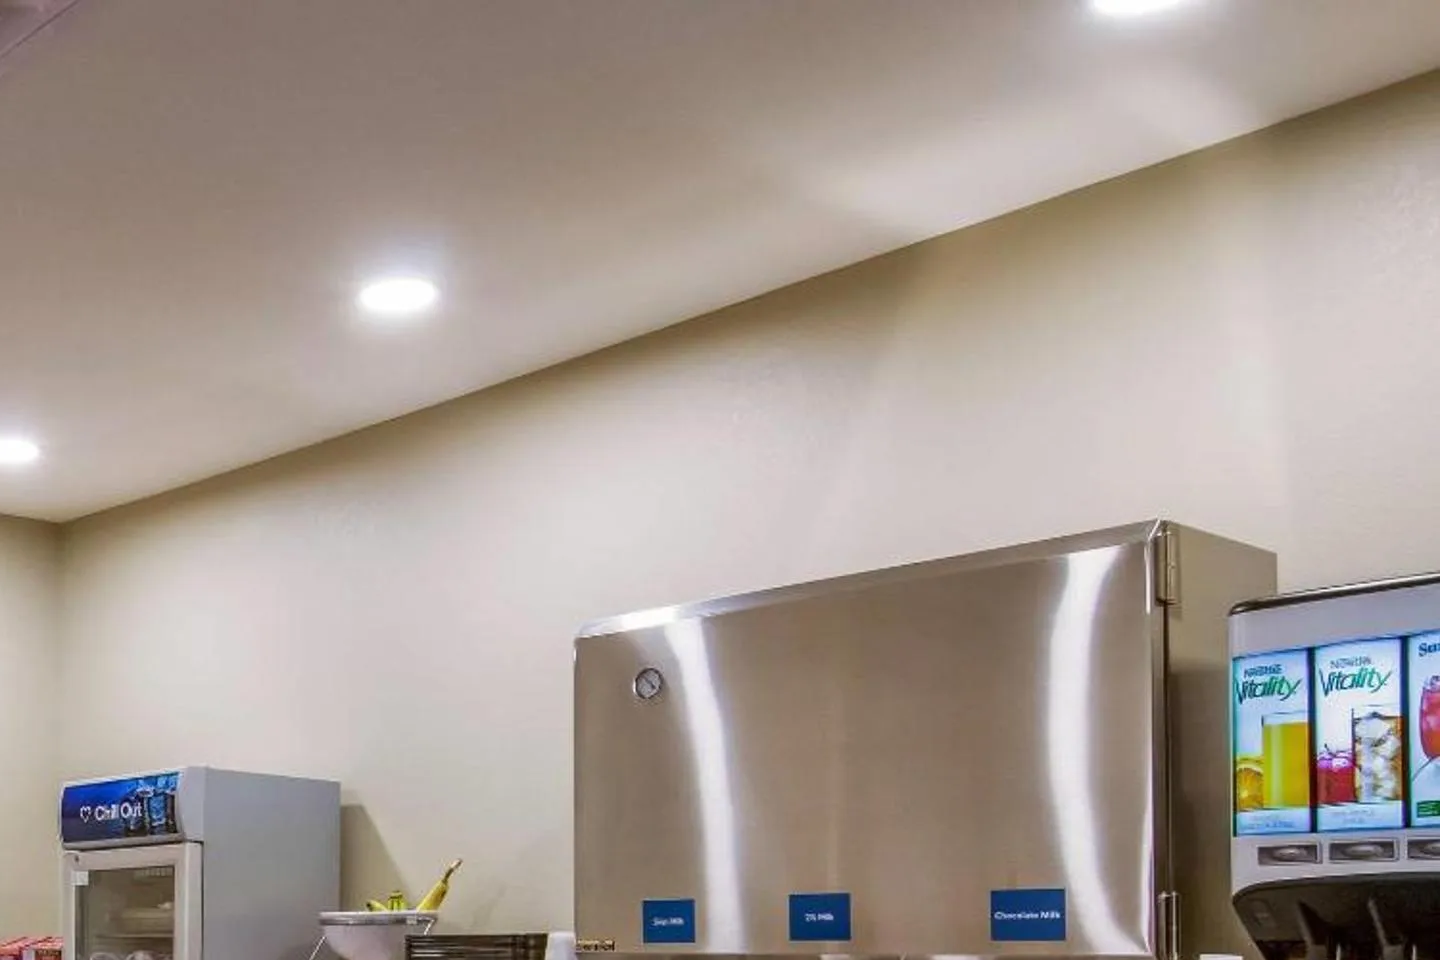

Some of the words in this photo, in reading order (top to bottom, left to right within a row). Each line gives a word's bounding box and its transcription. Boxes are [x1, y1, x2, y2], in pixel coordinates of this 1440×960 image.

[1234, 675, 1302, 704] Vitality
[1319, 666, 1392, 697] Vitality
[95, 804, 119, 821] Chill
[120, 802, 142, 819] Out
